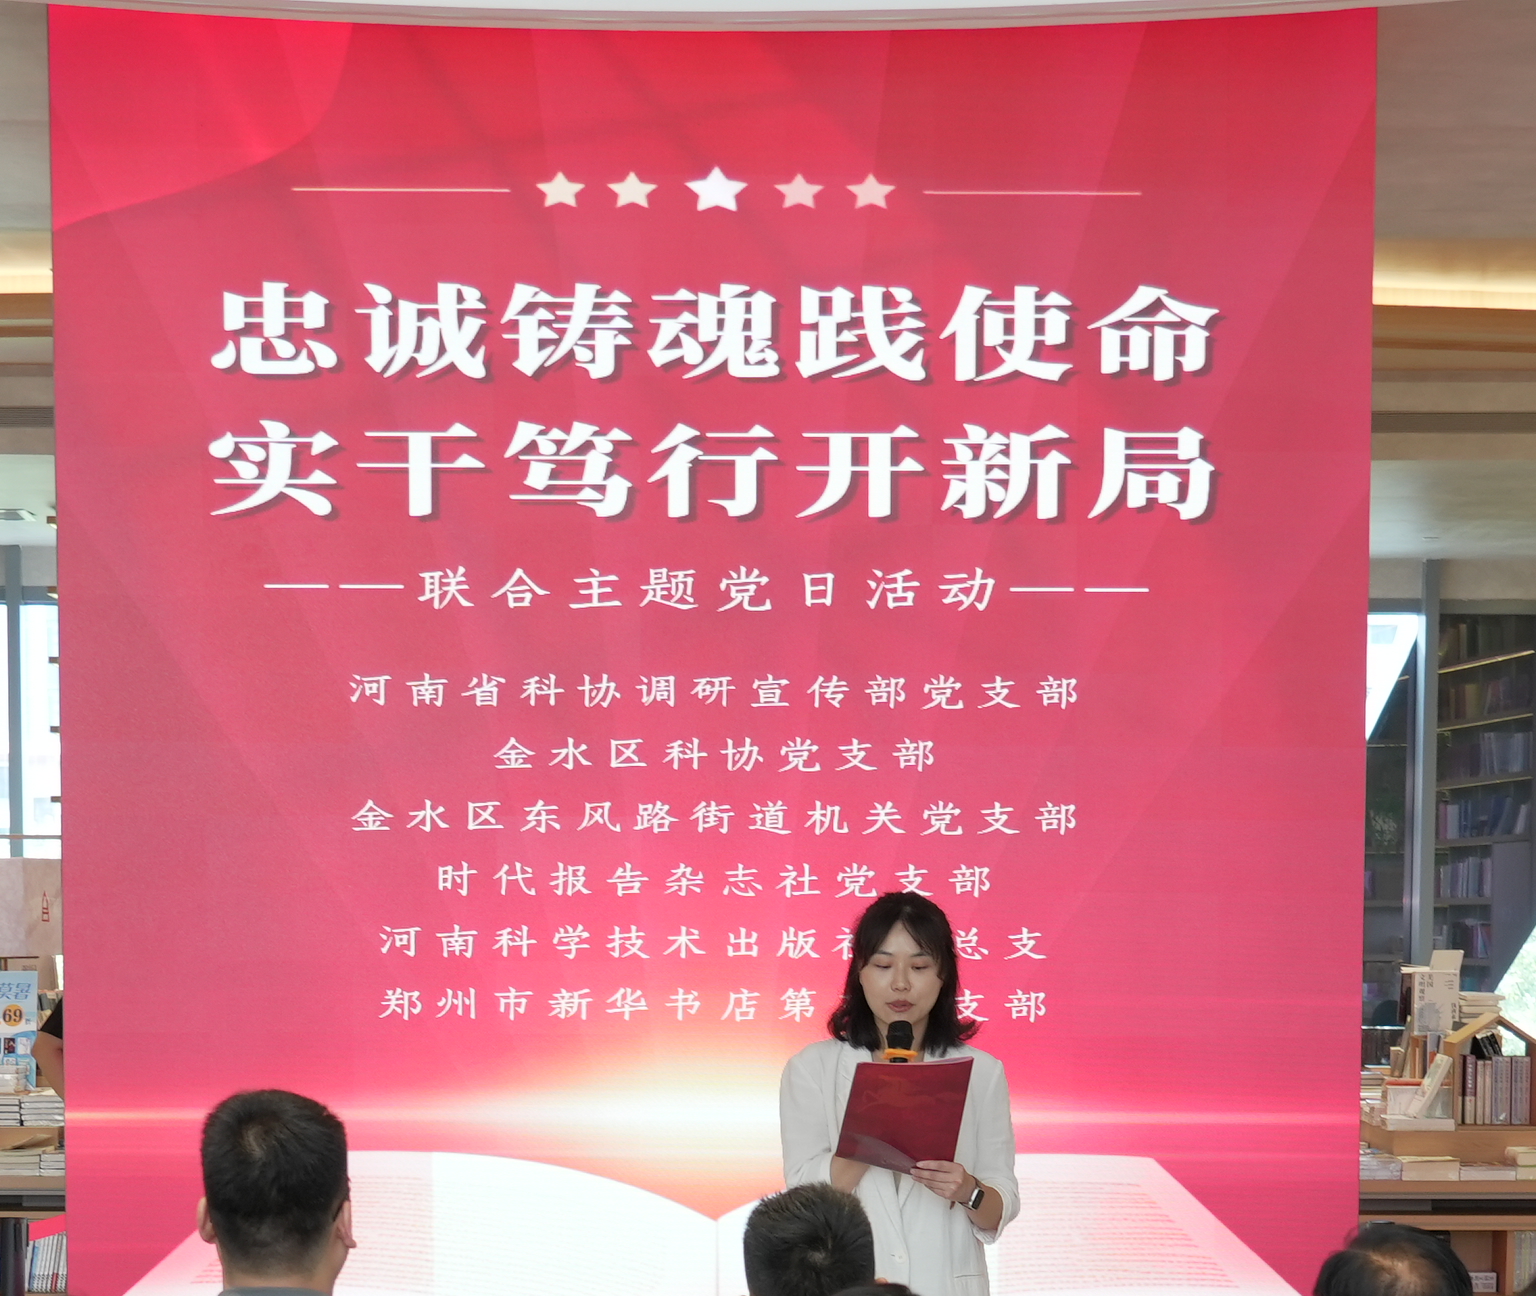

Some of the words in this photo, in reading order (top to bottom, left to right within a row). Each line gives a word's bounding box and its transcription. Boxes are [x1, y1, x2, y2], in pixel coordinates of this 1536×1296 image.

[210, 281, 1221, 382] 忠诚铸魂践使命
[208, 419, 1217, 520] 实干笃行开新局
[349, 672, 1080, 711] 河南省科协调研宣传部党支部
[493, 736, 936, 773] 金水区科协党支部
[351, 799, 1078, 837] 金水区东风路街道机关党支部
[437, 861, 993, 899] 时代报告杂志社党支部
[3, 1008, 23, 1023] 69
